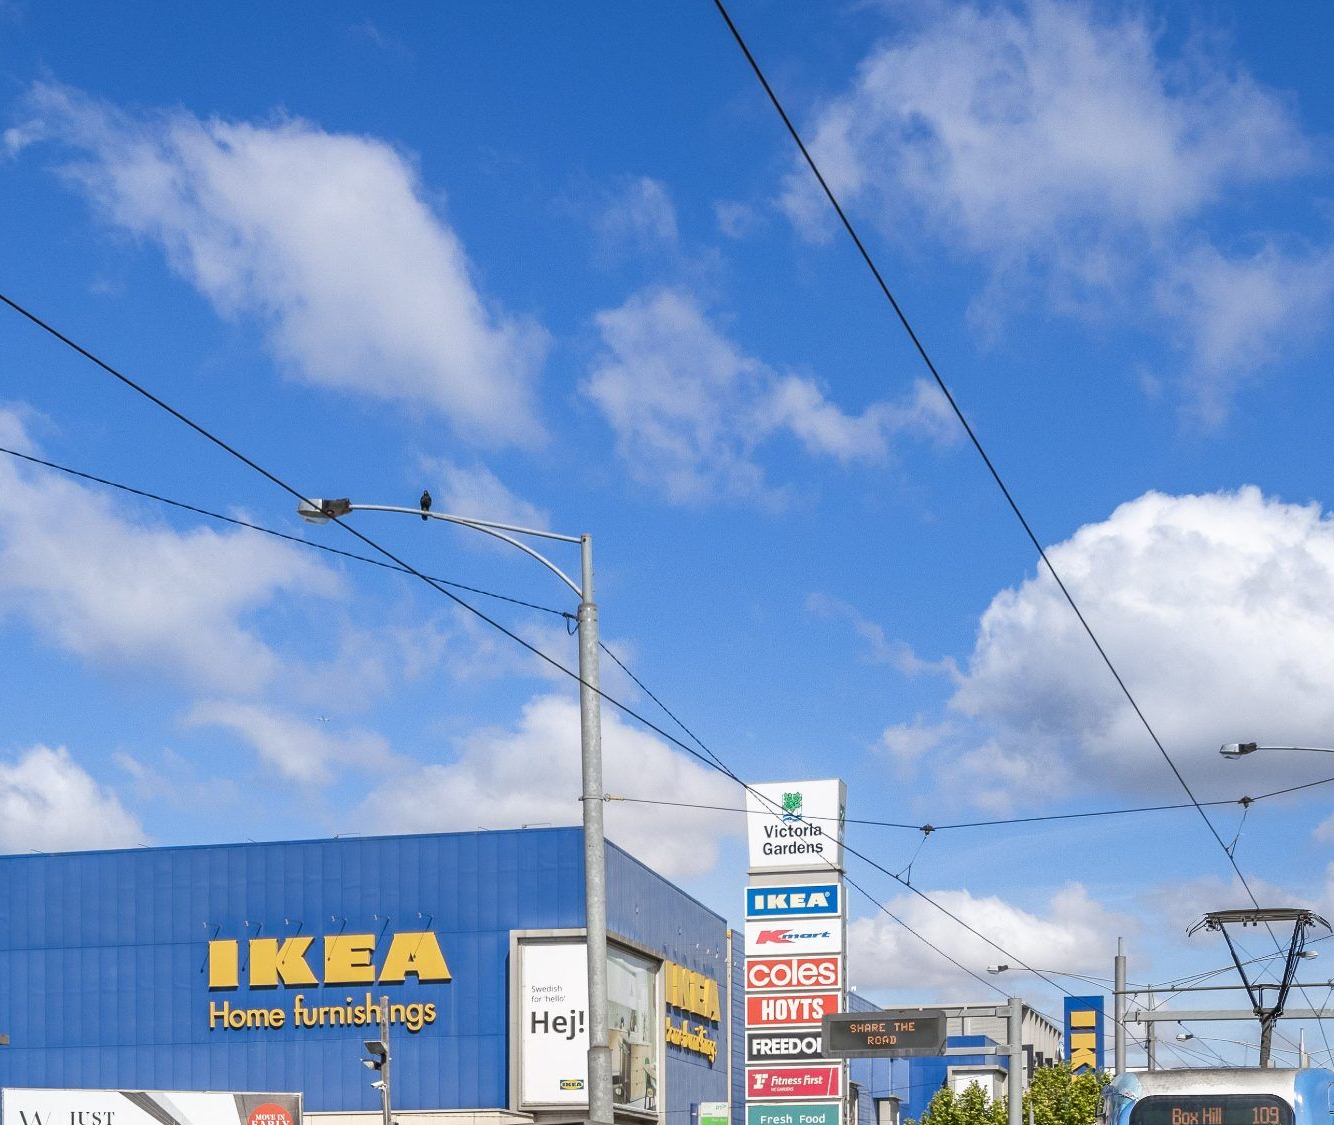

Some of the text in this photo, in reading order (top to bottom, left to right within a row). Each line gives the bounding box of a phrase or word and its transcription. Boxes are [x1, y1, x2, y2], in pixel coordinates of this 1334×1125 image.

[764, 823, 822, 838] Victoria
[763, 841, 823, 855] Gardens
[755, 929, 831, 945] Kmart
[208, 931, 453, 992] IKEA
[749, 959, 836, 987] coles
[531, 985, 563, 993] Swedish
[531, 995, 542, 1003] for
[209, 992, 437, 1033] Home furnishngs
[761, 997, 824, 1021] HOYTS
[531, 1009, 585, 1041] Hej!
[849, 1022, 915, 1033] SHARE THE
[867, 1035, 897, 1045] ROAD
[760, 1113, 826, 1124] Fresh Food
[1172, 1107, 1279, 1125] Box Hill 109
